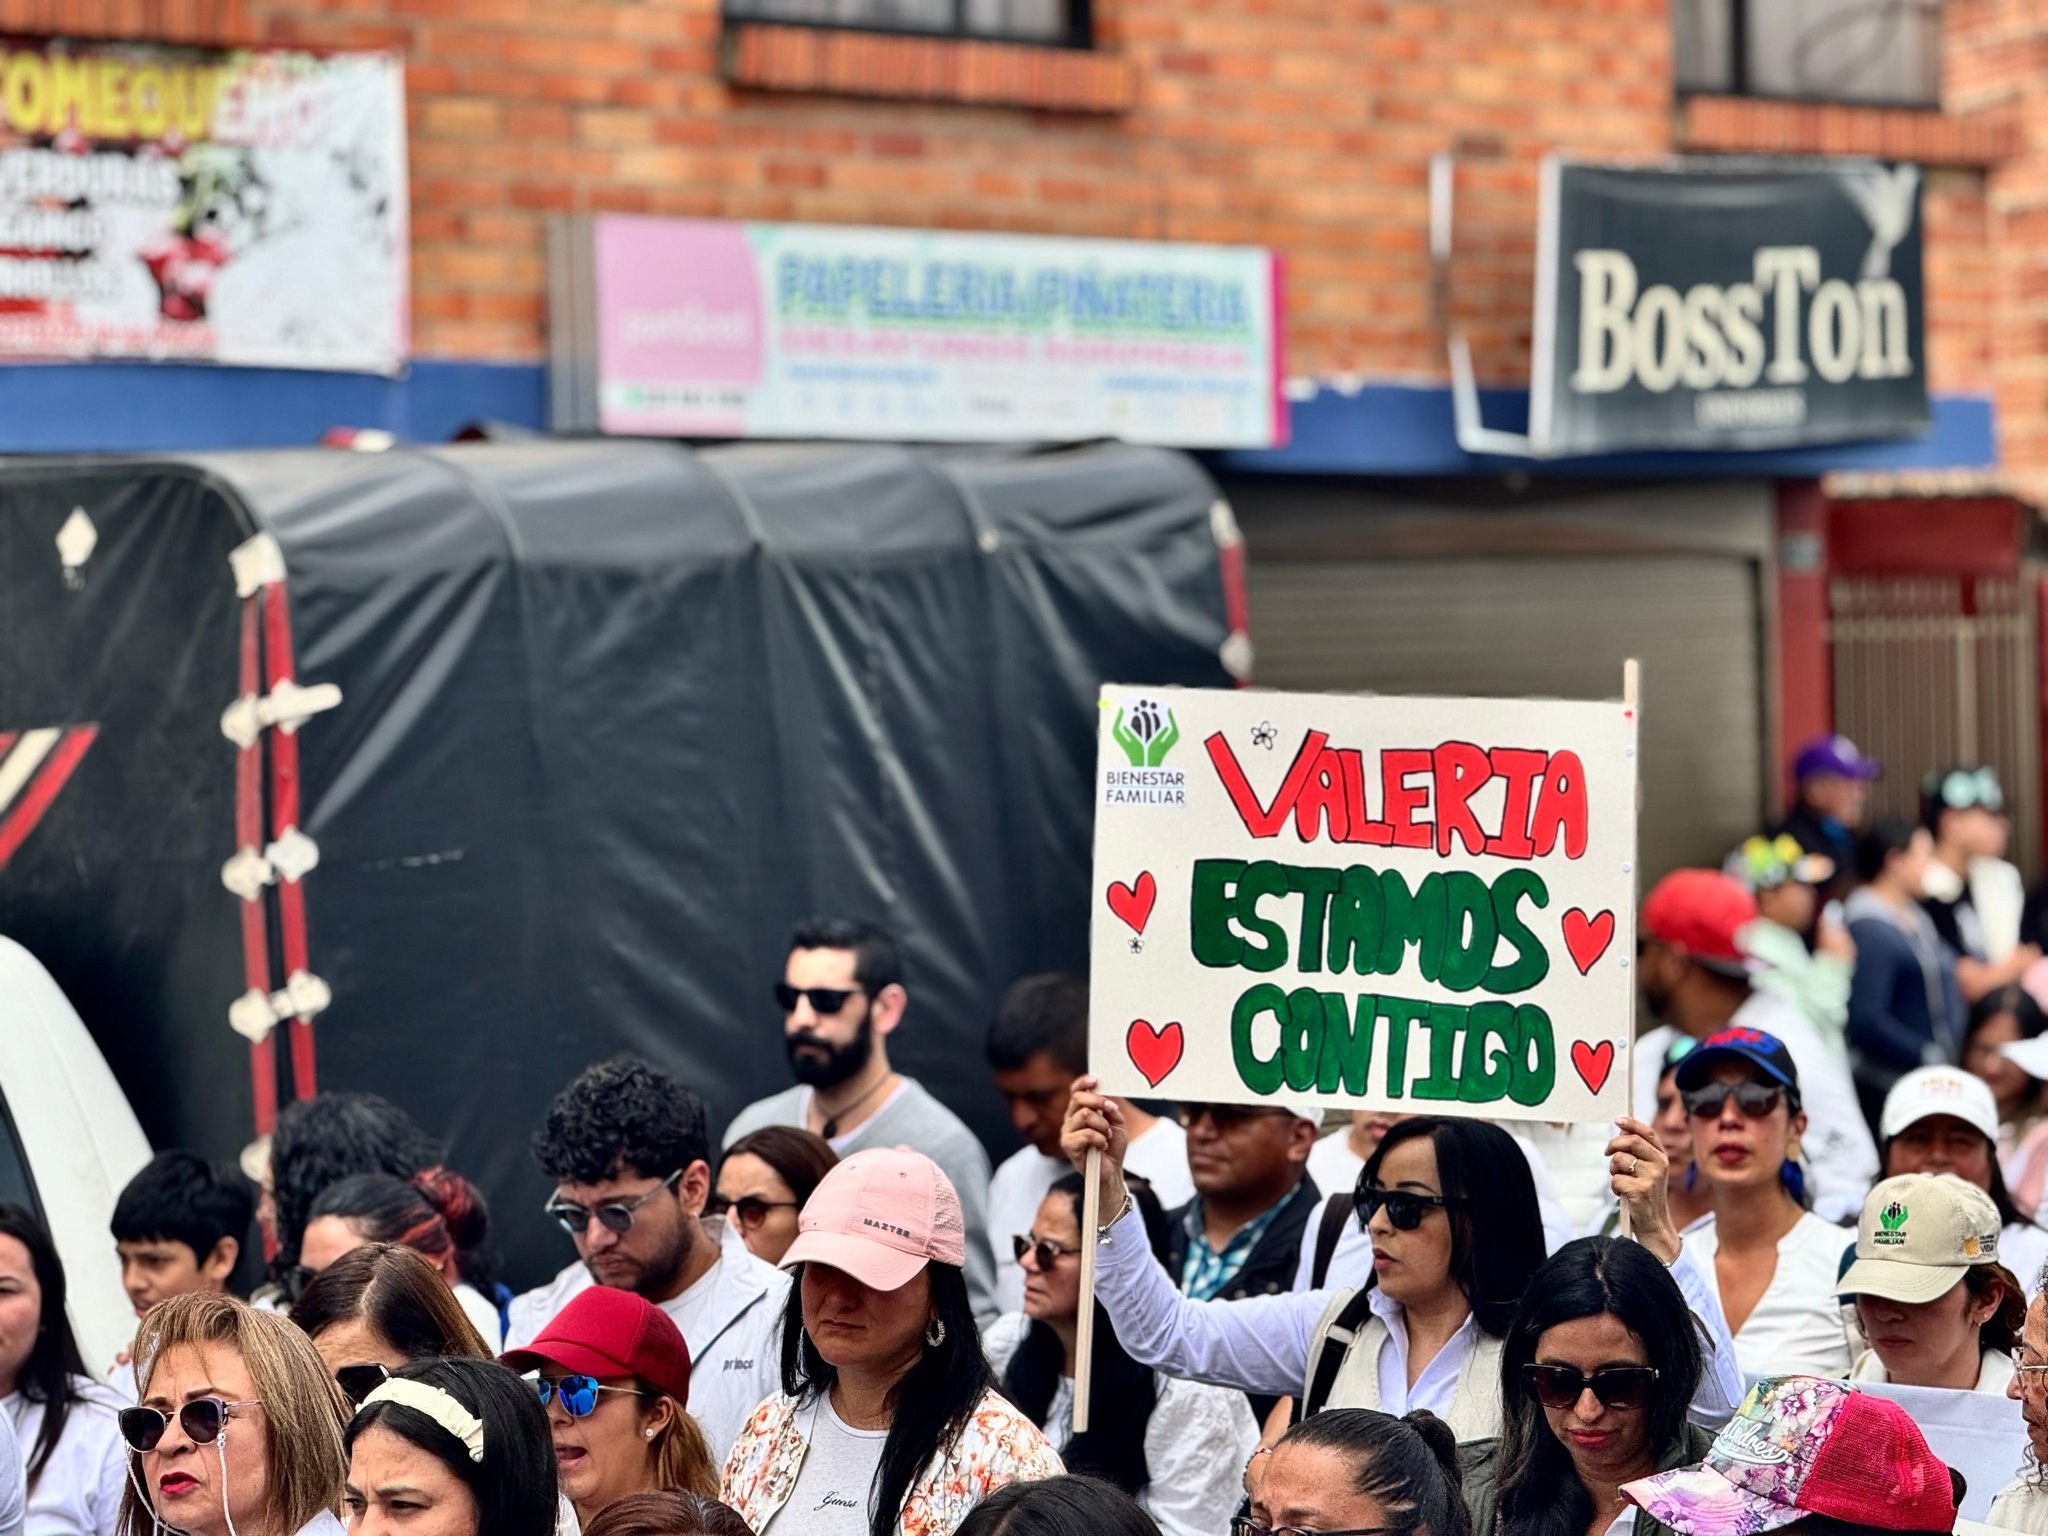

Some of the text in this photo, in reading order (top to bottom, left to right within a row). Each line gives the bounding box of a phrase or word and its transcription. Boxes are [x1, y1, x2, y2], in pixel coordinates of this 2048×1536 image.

[1570, 245, 1912, 393] BossTon
[1106, 771, 1185, 785] BIENESTAR
[1105, 789, 1185, 804] FAMILIAR
[1204, 729, 1588, 859] VALERIA
[1191, 858, 1550, 994] ESTAMOS
[1231, 983, 1556, 1106] CONTIGO
[863, 1218, 910, 1239] MAZTER
[1874, 1230, 1907, 1238] BIENESTAR
[1873, 1238, 1905, 1246] FAMILIAR
